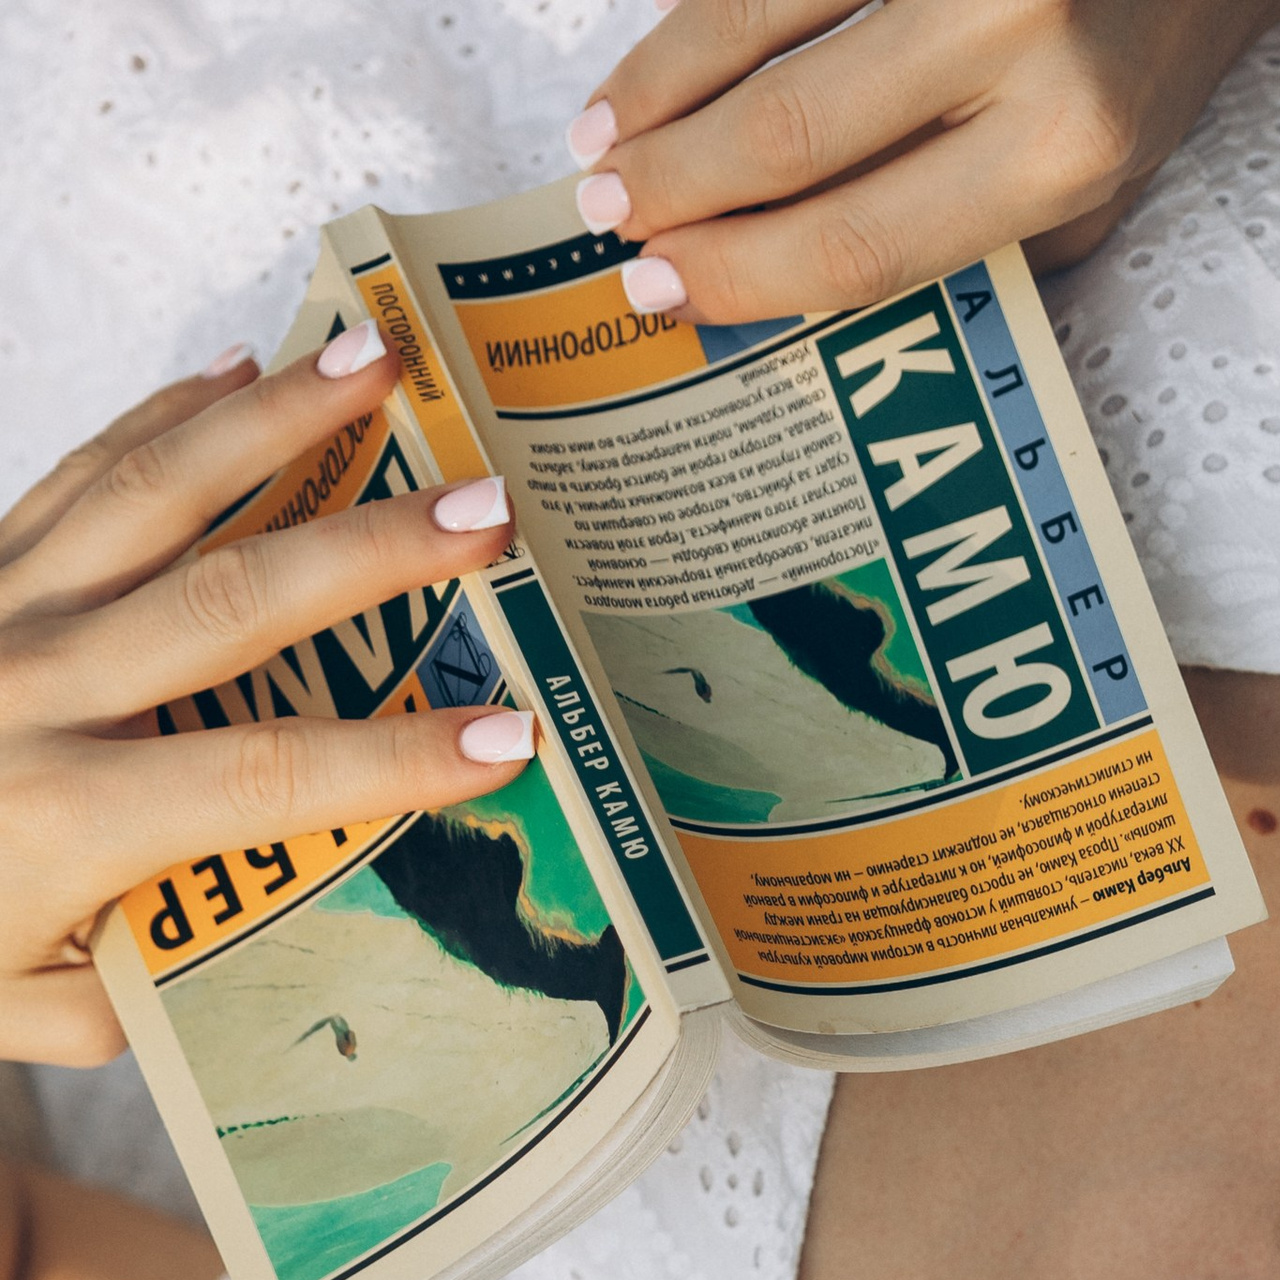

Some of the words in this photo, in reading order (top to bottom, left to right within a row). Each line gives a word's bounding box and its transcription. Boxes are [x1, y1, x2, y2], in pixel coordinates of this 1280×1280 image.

[370, 282, 445, 402] ПОСТОРОННИЙ
[797, 467, 811, 482] за
[815, 451, 850, 476] судят
[801, 474, 857, 505] постулат
[955, 290, 1129, 681] АЛЬБЕР
[657, 511, 676, 524] он
[677, 497, 731, 520] которое
[764, 496, 799, 518] этого
[811, 496, 866, 525] Понятие
[574, 520, 591, 532] по
[591, 514, 657, 532] совершил
[834, 311, 1072, 740] КАМЮ
[564, 538, 615, 551] повести
[616, 536, 646, 553] этой
[647, 530, 686, 547] Героя
[730, 517, 808, 553] абсолютной
[671, 542, 729, 564] свободы
[713, 540, 809, 580] своеобразный
[586, 557, 648, 572] основной
[636, 568, 713, 592] творческий
[690, 577, 755, 603] дебютная
[584, 594, 644, 609] молодого
[644, 590, 690, 610] работа
[546, 675, 609, 771] АЛЬБЕР
[595, 781, 649, 860] КАМЮ
[1135, 750, 1153, 766] ни
[1019, 759, 1134, 809] стилистическому.
[1108, 772, 1160, 801] степени
[1017, 793, 1107, 833] относящаяся,
[1085, 793, 1168, 836] литературой
[999, 826, 1016, 841] не
[1074, 825, 1084, 838] и
[1120, 814, 1176, 842] школы».
[932, 832, 997, 862] подлежит
[988, 827, 1073, 869] философией,
[1078, 836, 1119, 859] Проза
[1130, 843, 1165, 863] века,
[866, 853, 930, 877] старению
[958, 864, 968, 876] к
[969, 859, 987, 873] но
[1035, 852, 1078, 873] Камю,
[1065, 856, 1128, 886] писатель,
[1137, 856, 1191, 886] Альбер
[750, 871, 832, 887] моральному,
[833, 870, 851, 882] ни
[882, 867, 957, 895] литературе
[970, 872, 1016, 896] просто
[1017, 867, 1034, 881] не
[743, 893, 787, 908] равной
[787, 895, 797, 907] в
[797, 885, 869, 909] философии
[870, 886, 881, 898] и
[998, 881, 1063, 913] стоявший
[1092, 878, 1136, 902] Камю
[862, 887, 969, 921] балансирующая
[989, 898, 997, 914] у
[999, 895, 1078, 933] уникальная
[764, 911, 805, 926] между
[806, 910, 843, 926] грани
[844, 911, 861, 923] на
[933, 905, 987, 928] истоков
[734, 928, 846, 946] «экзистенциальной
[848, 916, 932, 946] французской
[936, 924, 998, 949] личность
[757, 949, 812, 965] культуры
[870, 942, 924, 961] истории
[925, 940, 935, 952] в
[813, 950, 869, 969] мировой
